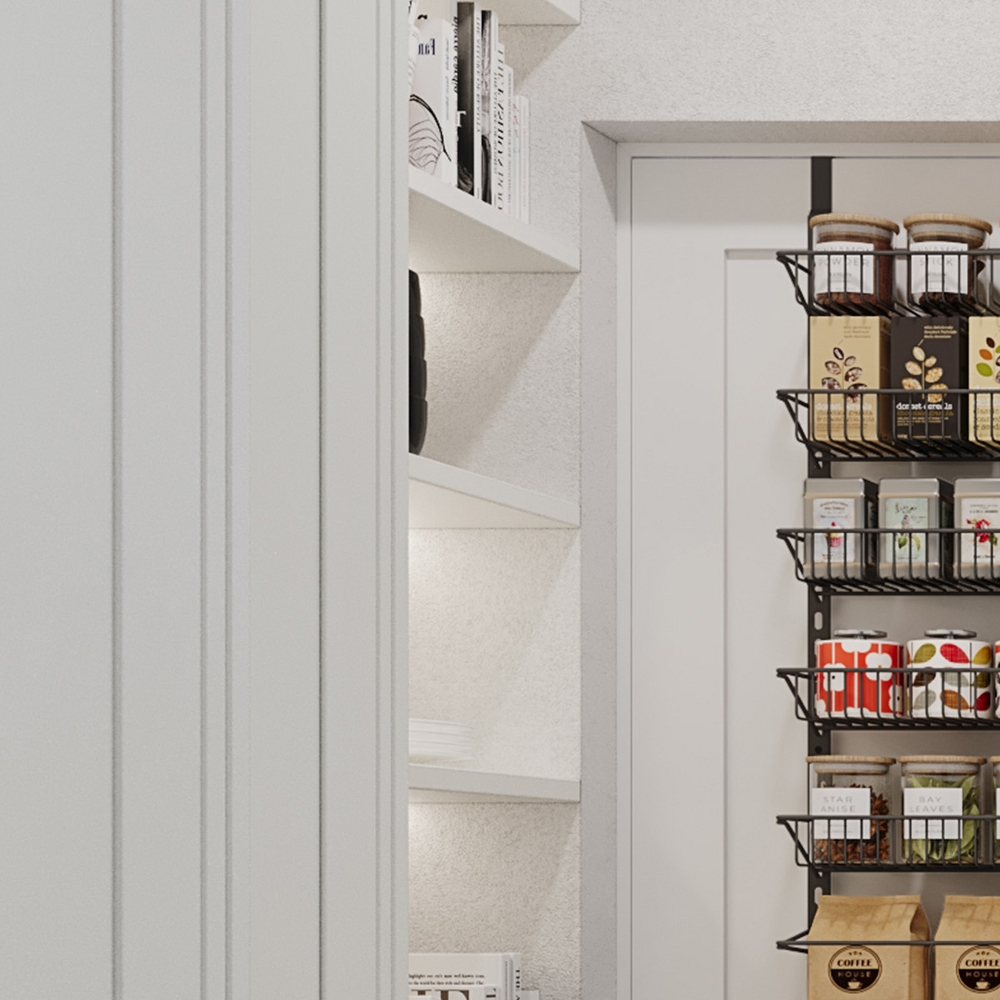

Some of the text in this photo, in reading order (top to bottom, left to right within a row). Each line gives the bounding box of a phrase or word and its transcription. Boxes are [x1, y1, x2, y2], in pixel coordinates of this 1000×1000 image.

[821, 805, 856, 813] ANISE
[910, 805, 954, 813] LEAVES
[837, 959, 873, 967] COFFEE
[965, 959, 1000, 967] COFFEE
